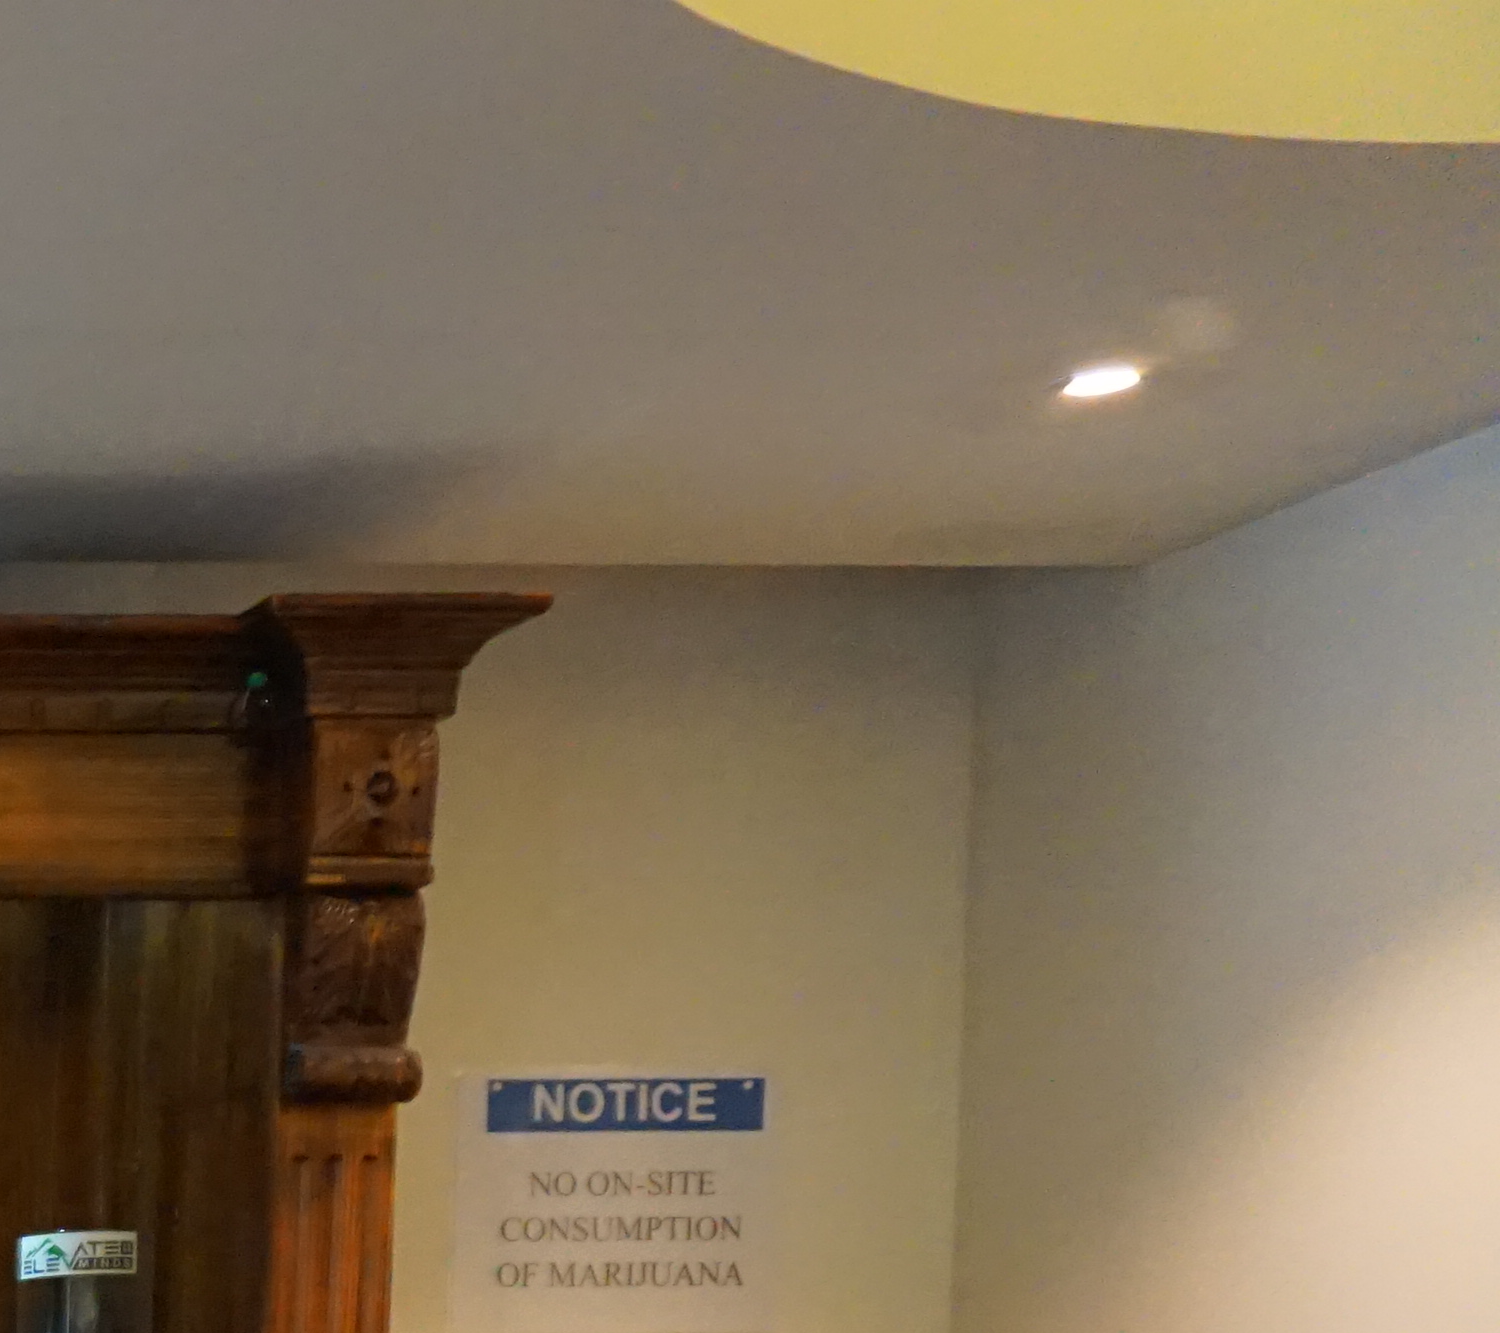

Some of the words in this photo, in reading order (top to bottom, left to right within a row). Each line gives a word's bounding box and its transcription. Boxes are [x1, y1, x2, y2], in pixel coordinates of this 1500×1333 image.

[532, 1081, 717, 1123] NOTICE
[528, 1170, 578, 1197] NO
[587, 1170, 717, 1198] ON-SITE
[499, 1215, 744, 1243] CONSUMPTION
[77, 1257, 134, 1270] MINDS
[496, 1261, 539, 1288] OF
[549, 1261, 745, 1288] MARIJUANA
